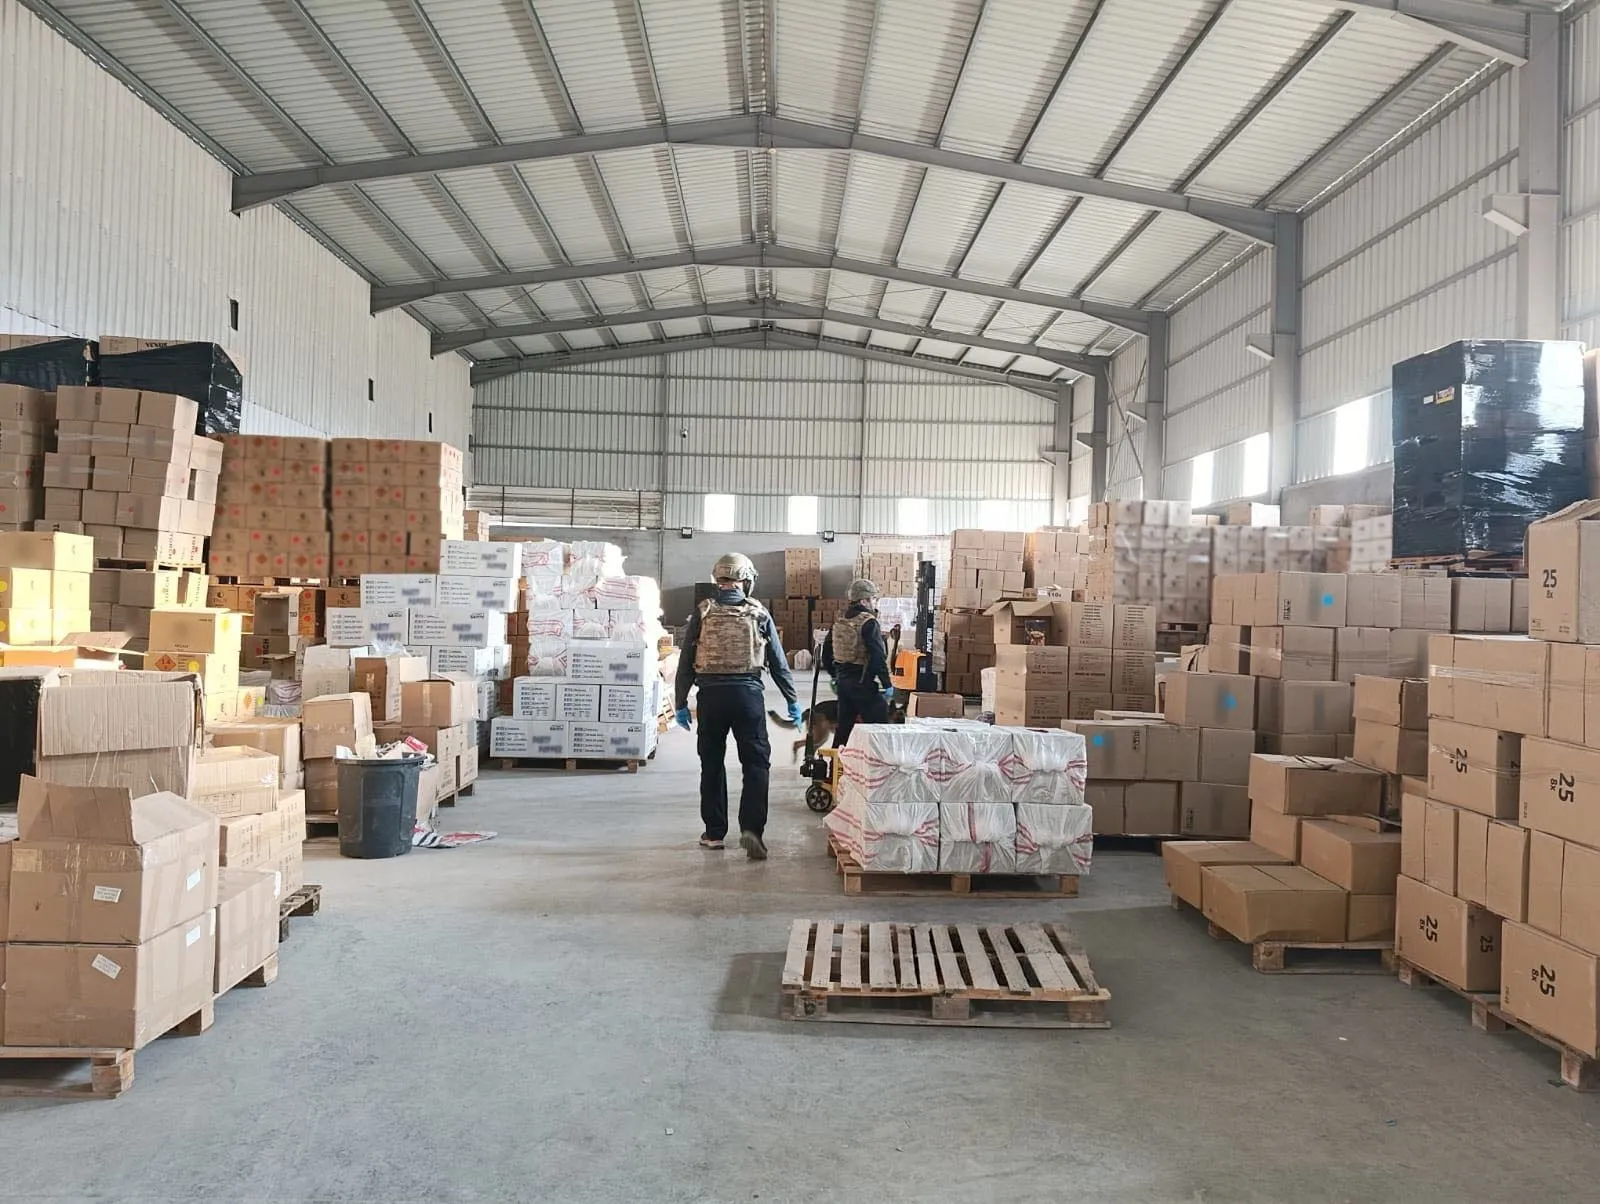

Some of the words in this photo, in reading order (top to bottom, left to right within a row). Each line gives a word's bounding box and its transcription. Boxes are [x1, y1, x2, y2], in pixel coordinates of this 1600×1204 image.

[1543, 568, 1557, 588] 25
[1456, 748, 1468, 774] 25
[1550, 778, 1557, 791] 8x
[1558, 773, 1575, 803] 25
[1426, 915, 1438, 943] 25
[1480, 935, 1494, 953] 25
[1531, 969, 1539, 982] 8x
[1540, 965, 1556, 998] 25
